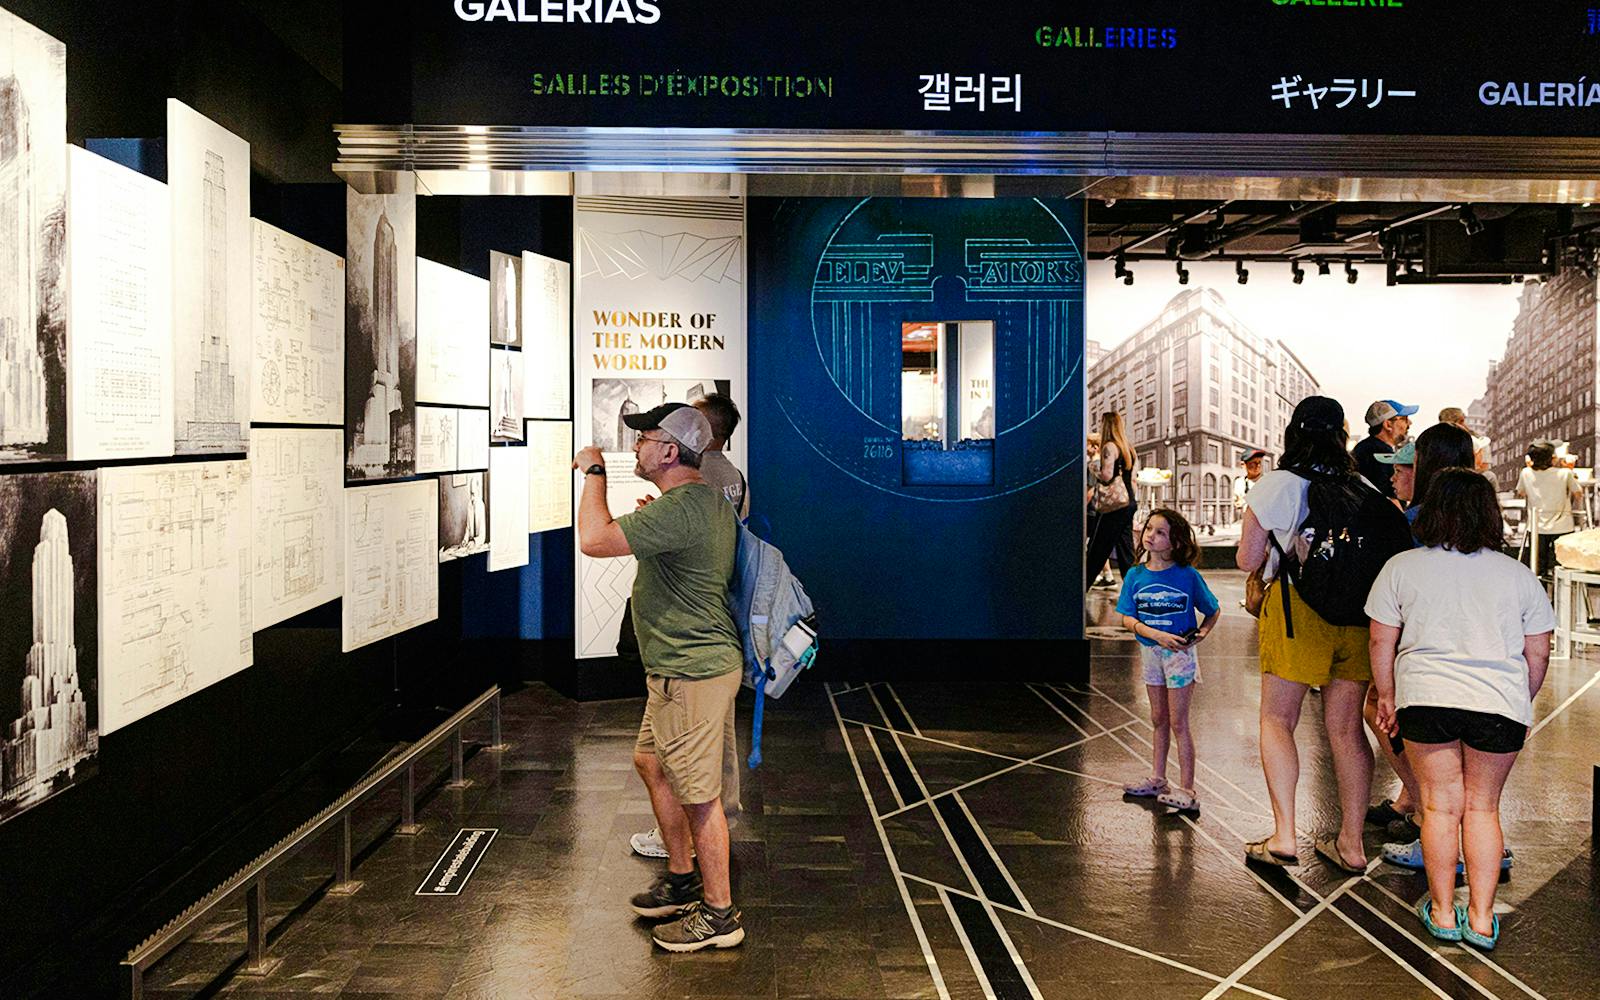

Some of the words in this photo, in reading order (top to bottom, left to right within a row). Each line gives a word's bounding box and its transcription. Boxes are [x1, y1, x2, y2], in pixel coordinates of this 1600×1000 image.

[1035, 26, 1177, 49] GALLERIES
[532, 72, 631, 97] SALLES
[918, 72, 1022, 112] 갤러리
[1271, 75, 1416, 109] ギャラリー
[1478, 75, 1600, 107] GALERÍA
[592, 310, 682, 329] WONDER
[690, 312, 717, 330] OF
[592, 332, 632, 349] THE
[640, 333, 725, 351] MODERN
[592, 353, 667, 371] WORLD
